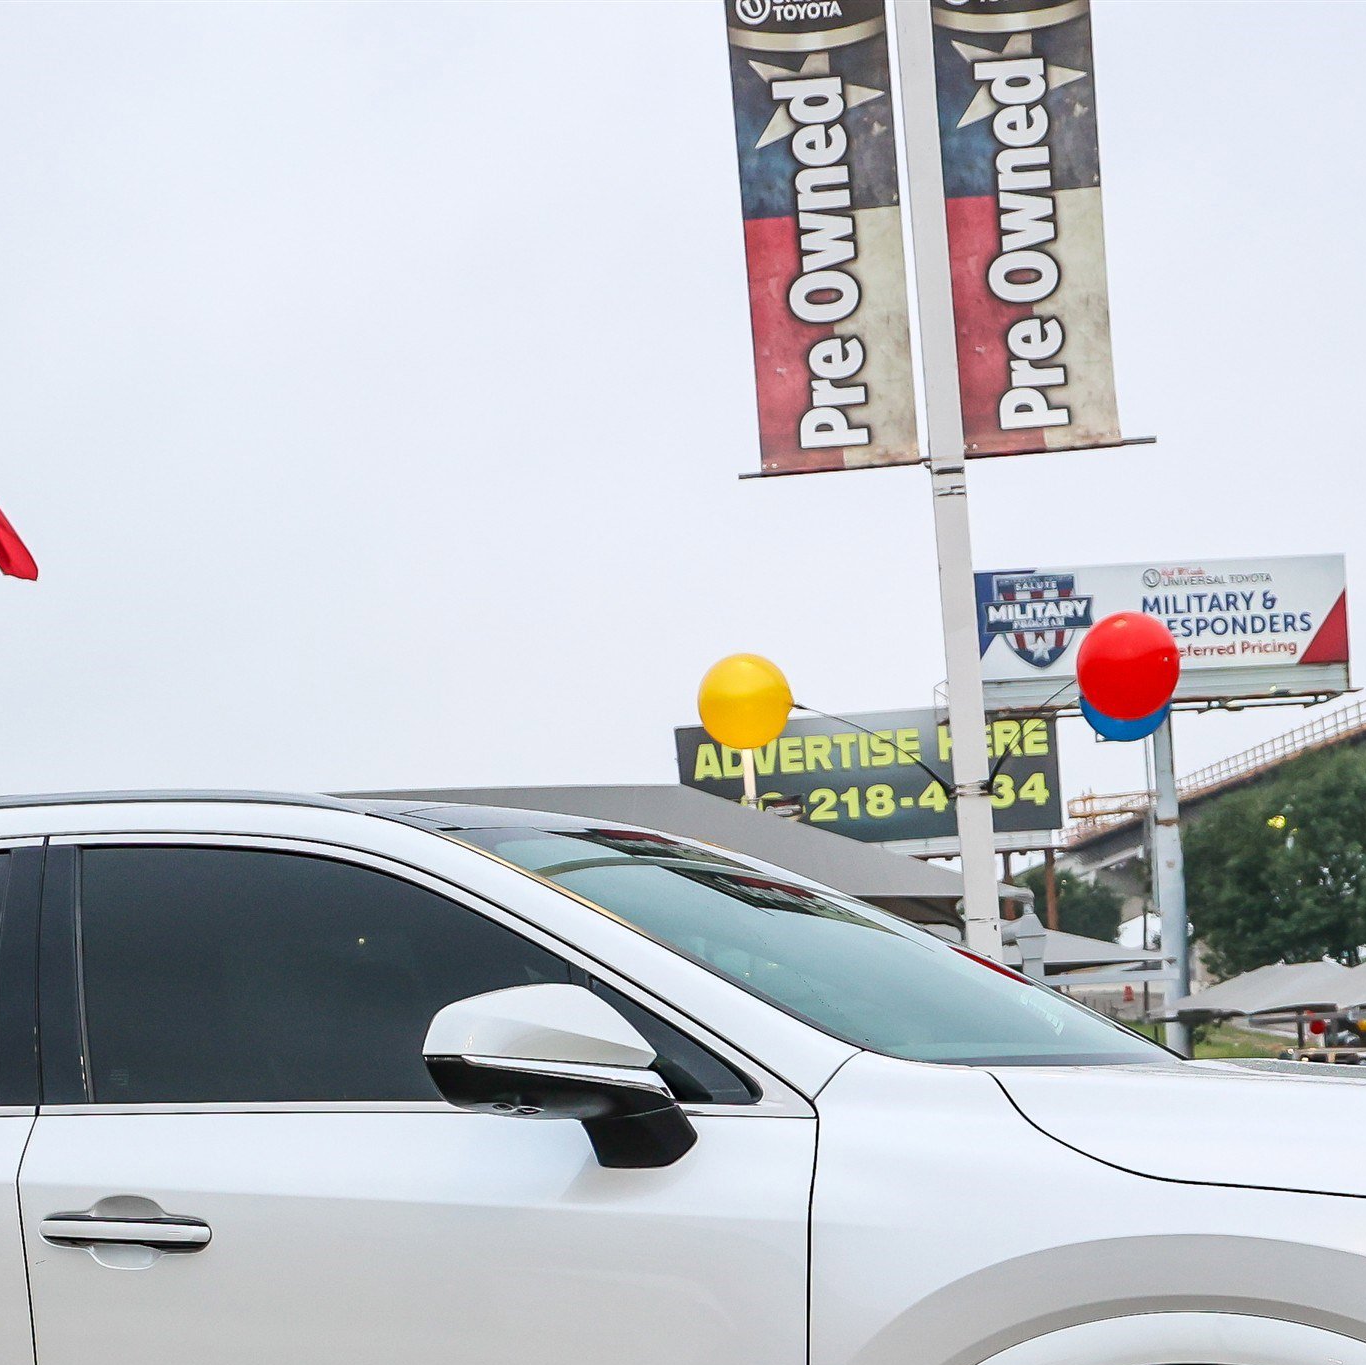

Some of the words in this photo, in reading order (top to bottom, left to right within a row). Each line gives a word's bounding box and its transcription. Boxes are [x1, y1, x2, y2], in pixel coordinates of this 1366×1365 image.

[772, 2, 842, 22] TOYOTA
[974, 58, 1059, 303] Owned
[772, 76, 860, 323] Owned
[999, 318, 1070, 430] Pre
[800, 337, 869, 449] Pre
[1015, 581, 1057, 590] SALUTE
[1229, 573, 1272, 583] TOYOTA
[988, 600, 1088, 621] MILITARY
[1142, 591, 1255, 614] MILITARY
[1263, 589, 1277, 610] &
[1167, 612, 1312, 637] ESPONDERS
[1179, 641, 1235, 657] eferred
[1242, 639, 1297, 655] Pricing
[694, 728, 921, 781] ADVERTISE
[938, 719, 1049, 762] HRE
[809, 772, 1050, 823] 218-434
